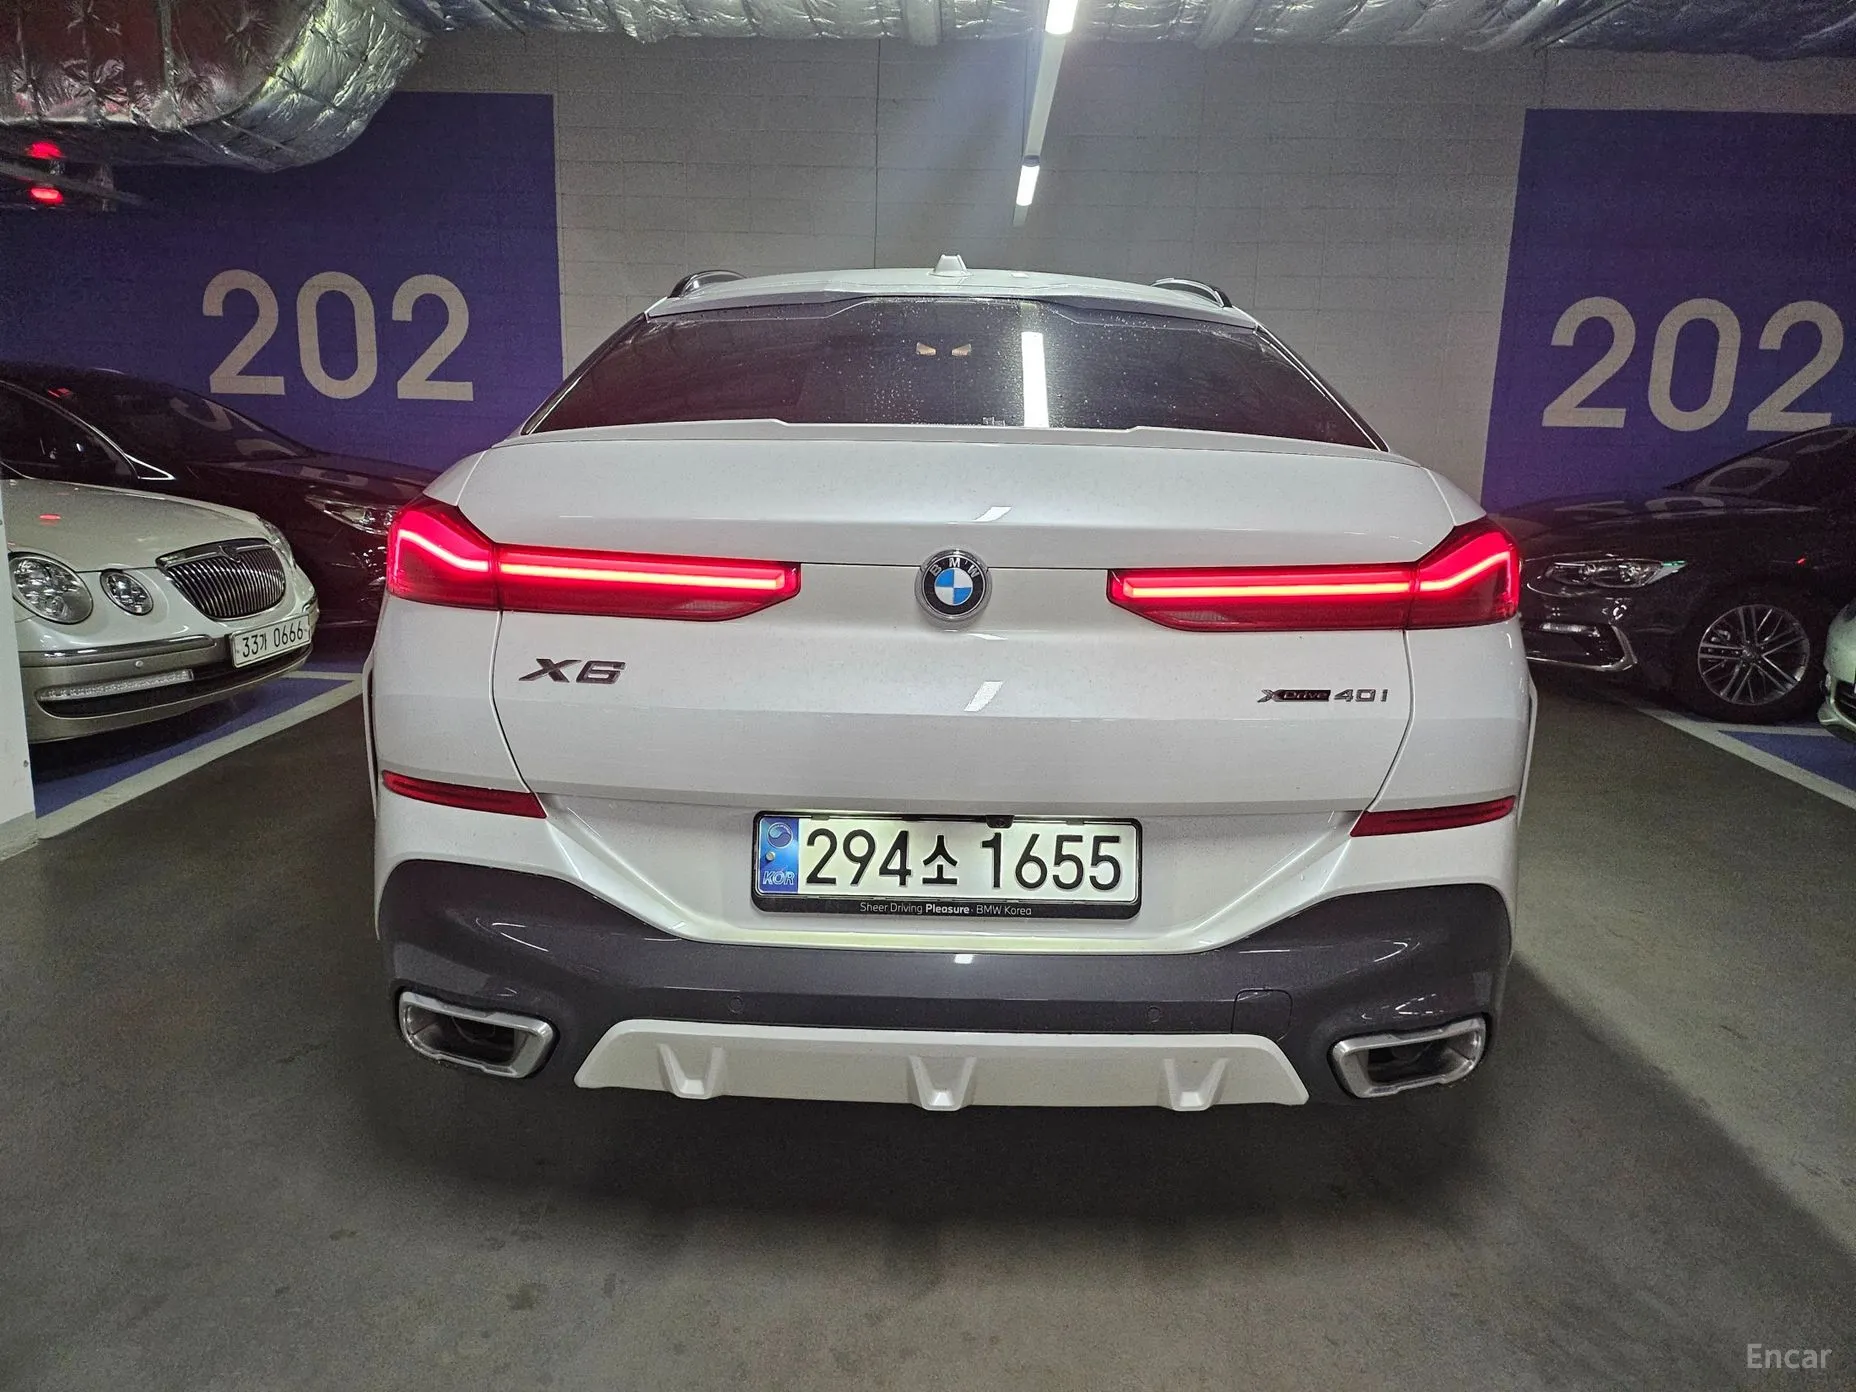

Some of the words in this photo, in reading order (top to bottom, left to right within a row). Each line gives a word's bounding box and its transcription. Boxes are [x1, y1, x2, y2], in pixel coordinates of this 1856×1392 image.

[202, 268, 474, 401] 202
[1541, 296, 1844, 431] 202
[929, 557, 980, 578] BMW
[273, 621, 304, 647] 0666
[518, 658, 626, 685] X6
[805, 828, 958, 886] 294소
[981, 832, 1121, 891] 1655
[762, 869, 795, 886] KOR
[860, 902, 888, 912] Sheer
[890, 902, 923, 914] Driving
[976, 905, 1002, 914] BMW
[1004, 906, 1032, 916] Korea
